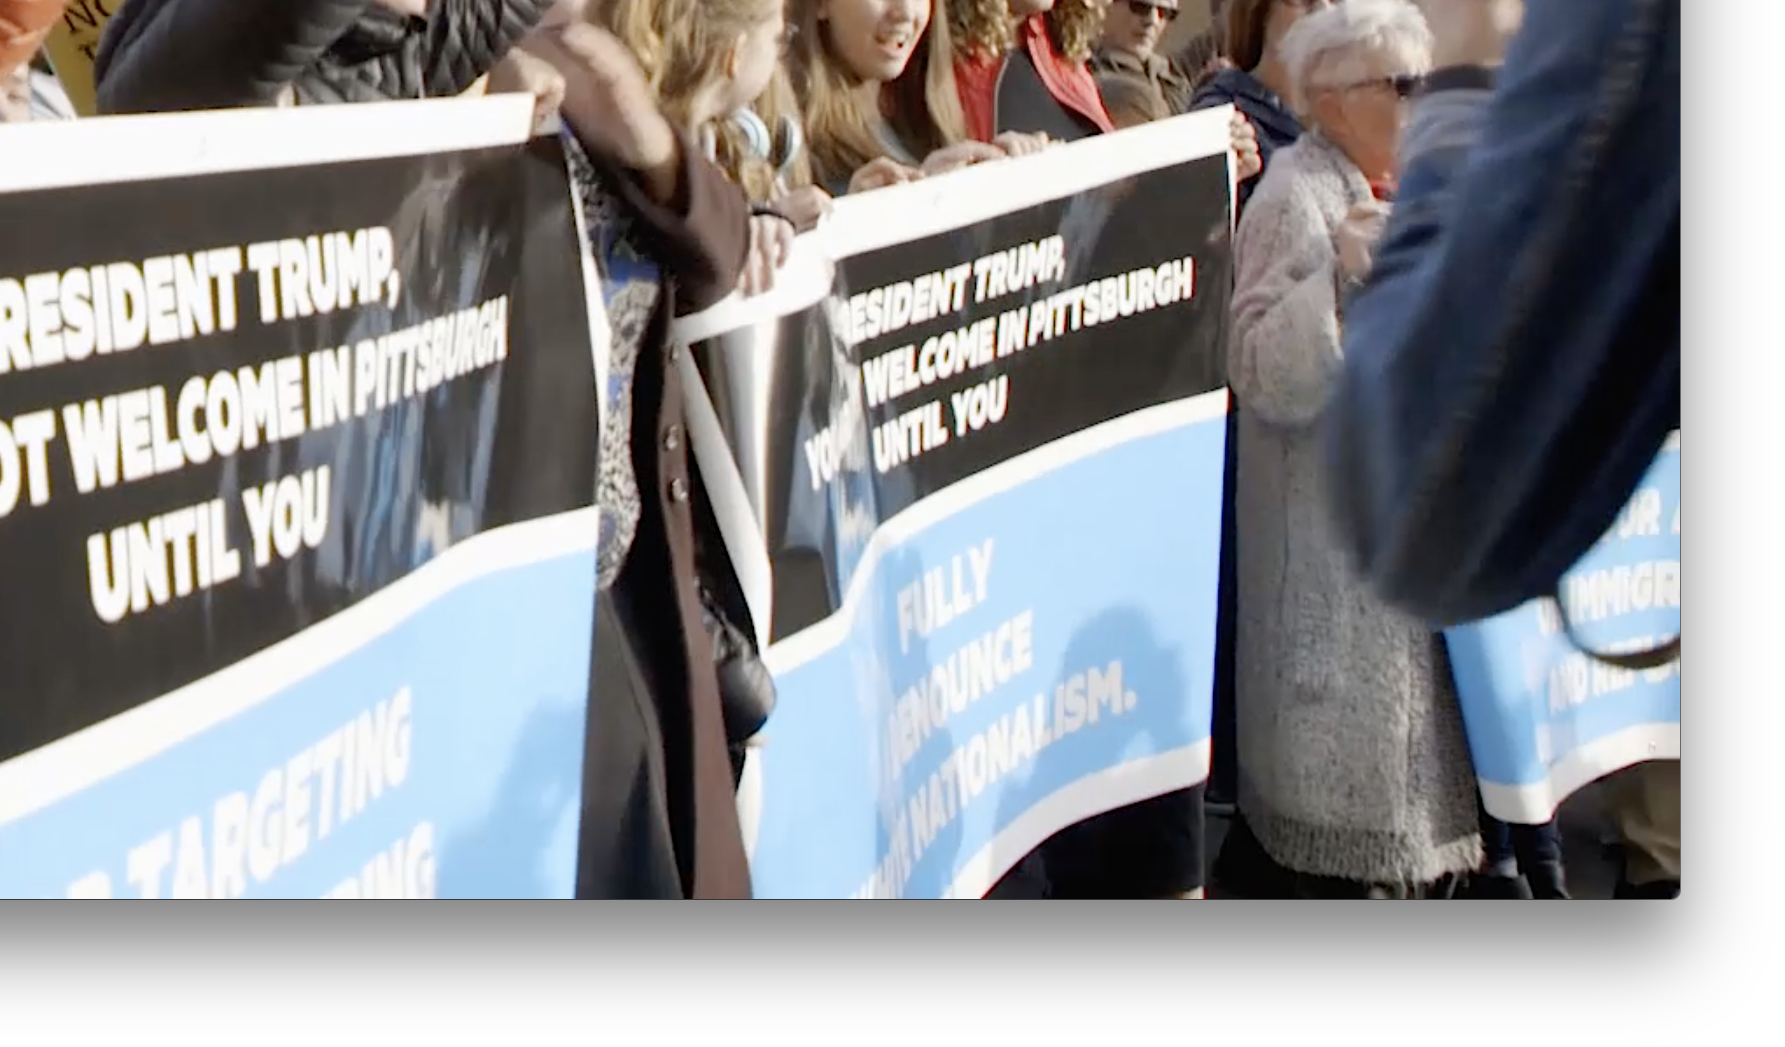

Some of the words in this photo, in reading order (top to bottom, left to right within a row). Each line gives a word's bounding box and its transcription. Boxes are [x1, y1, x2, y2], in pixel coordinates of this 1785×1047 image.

[247, 225, 401, 324] TRUMP,
[862, 315, 998, 408] WELCOME
[996, 304, 1029, 358] IN
[1028, 256, 1194, 347] PITTSBURGH
[974, 234, 1065, 304] TRUMP,
[62, 354, 306, 495] WELCOME
[308, 345, 351, 430] IN
[353, 293, 509, 418] PITTSBURGH
[871, 400, 949, 475] UNTIL
[951, 373, 1009, 437] YOU
[85, 497, 241, 623] UNTIL
[242, 464, 332, 567] YOU
[896, 537, 995, 654] FULLY
[126, 684, 412, 898] TARGETING
[910, 659, 1138, 862] NATIONALISM.
